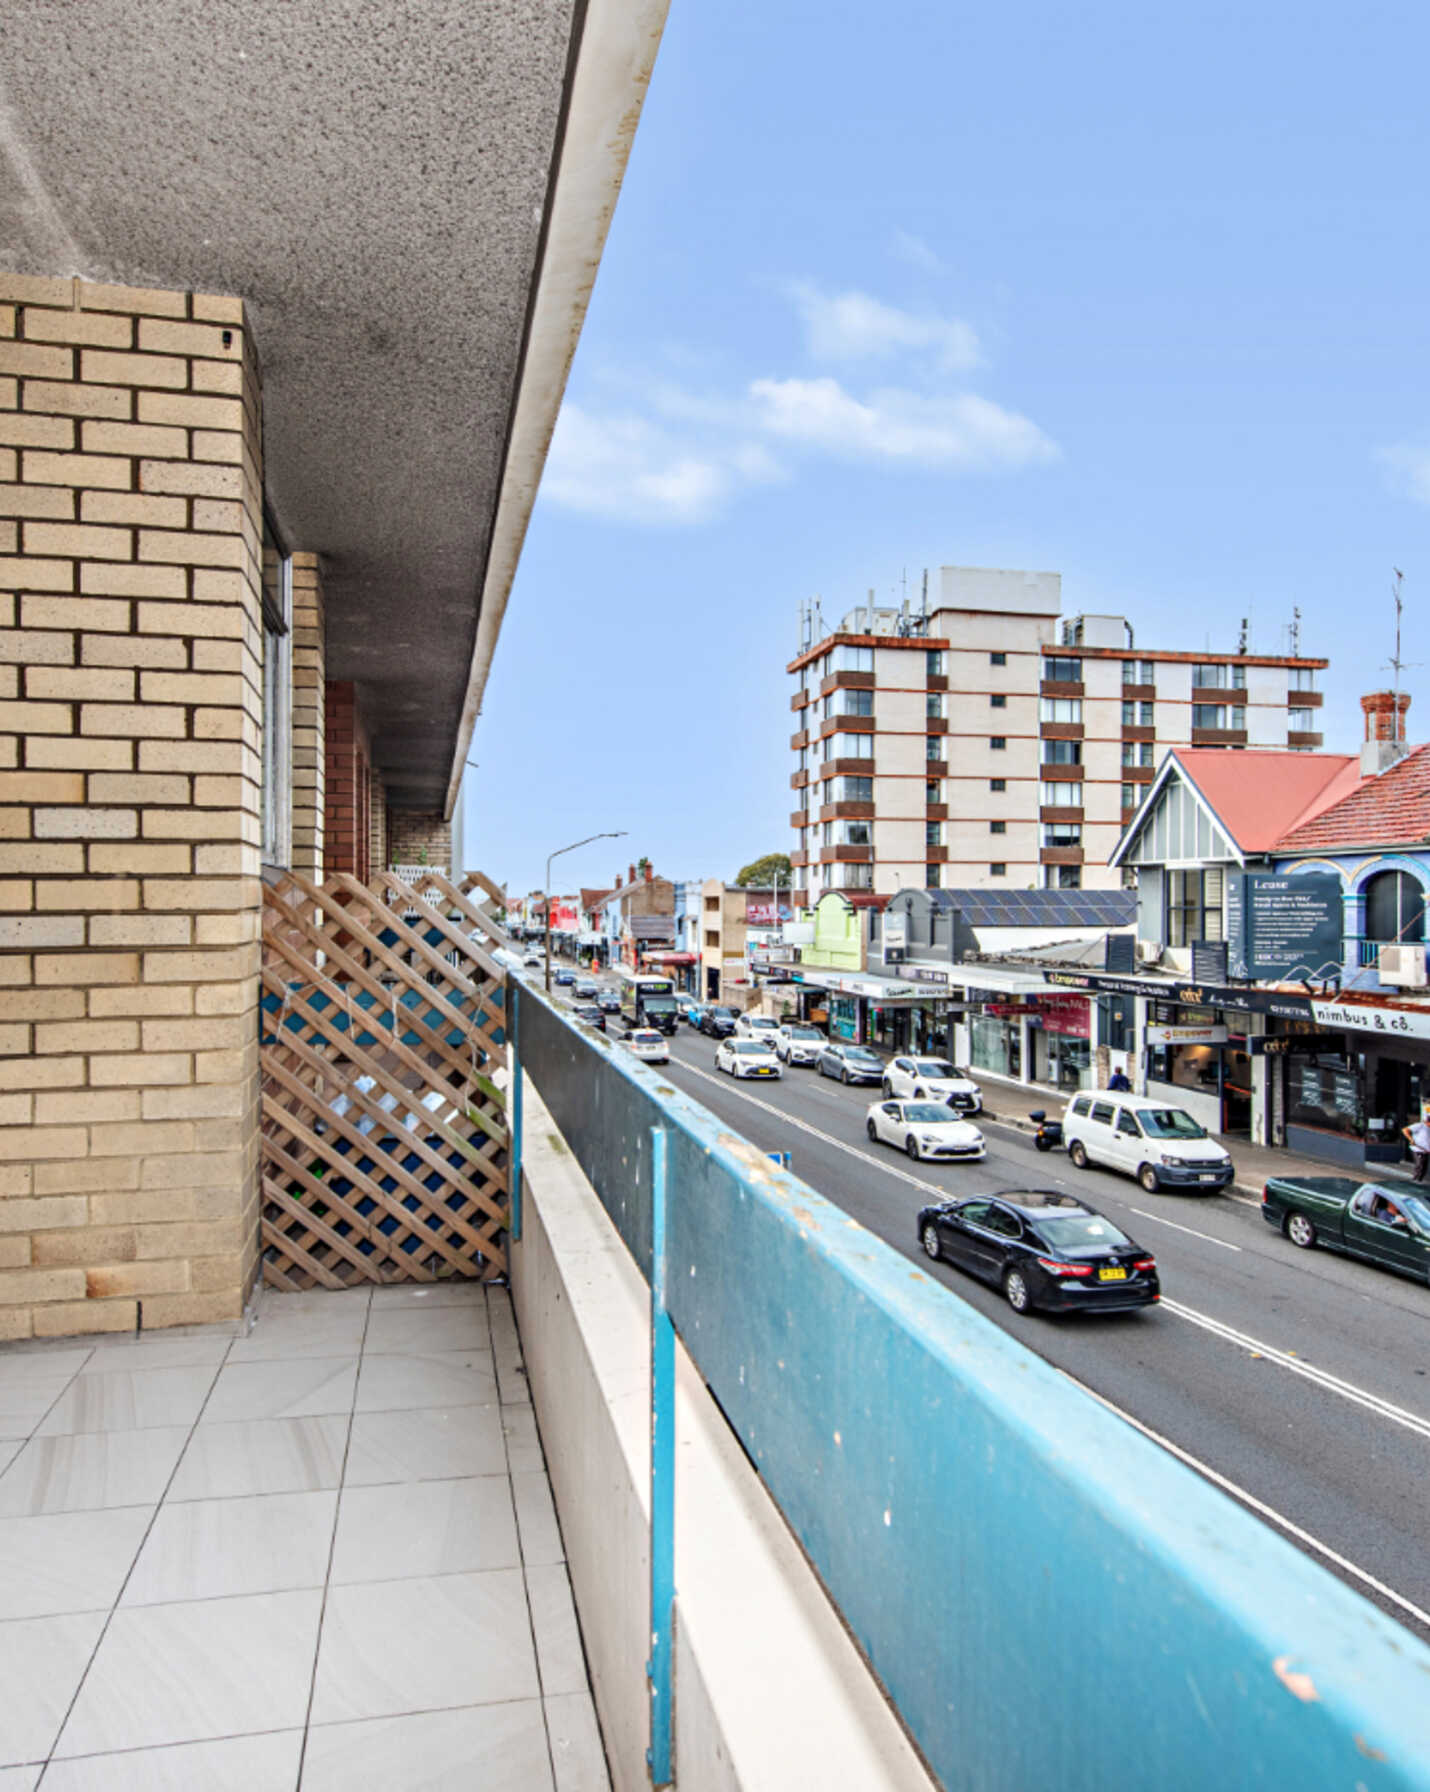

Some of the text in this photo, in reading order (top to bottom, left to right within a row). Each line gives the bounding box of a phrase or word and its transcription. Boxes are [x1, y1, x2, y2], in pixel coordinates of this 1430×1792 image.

[1254, 879, 1288, 889] Lease
[1317, 1007, 1368, 1026] nimbus
[1374, 1014, 1386, 1030] &
